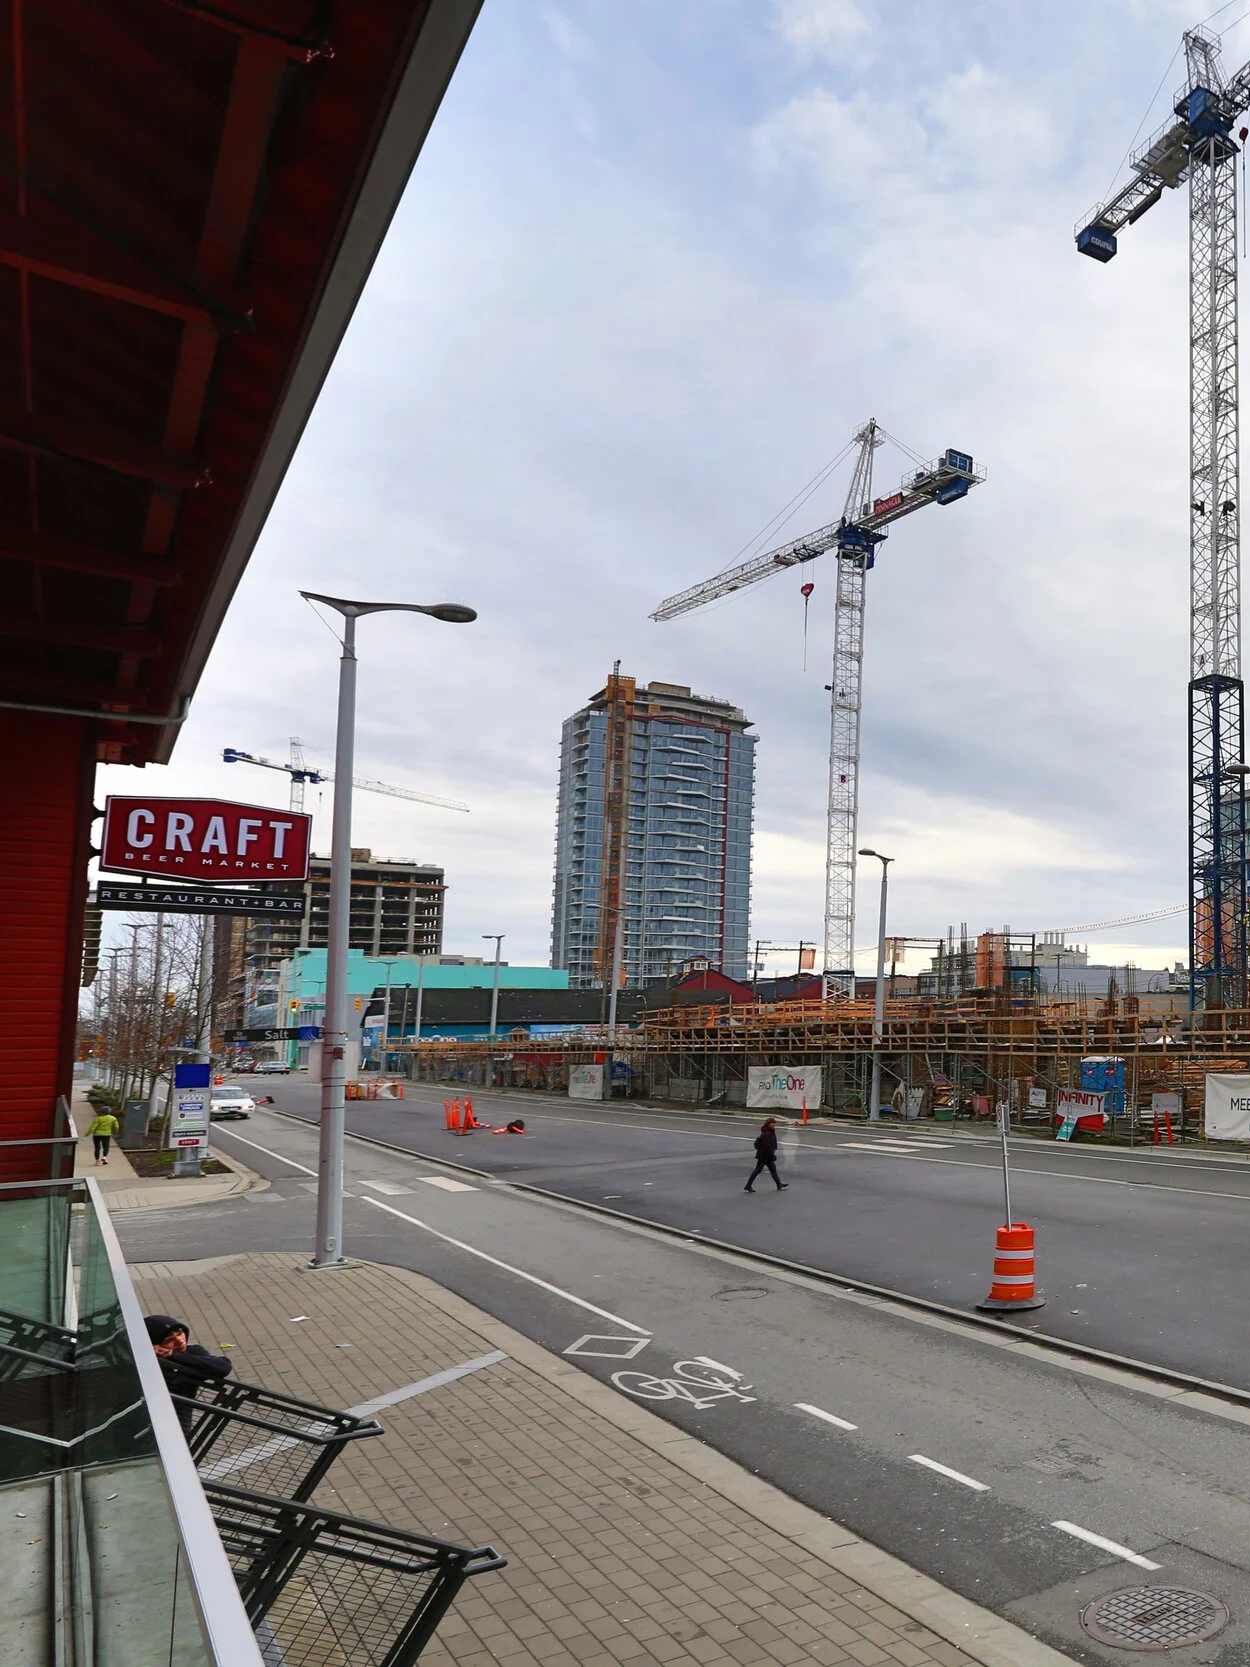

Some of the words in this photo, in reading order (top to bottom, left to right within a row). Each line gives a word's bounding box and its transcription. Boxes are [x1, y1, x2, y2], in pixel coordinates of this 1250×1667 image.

[127, 808, 293, 859] CRAFT
[124, 853, 185, 863] BEER
[202, 858, 290, 870] MARKET
[264, 1030, 289, 1040] Salt
[771, 1074, 805, 1091] TheOne
[1058, 1090, 1104, 1112] INFINITY
